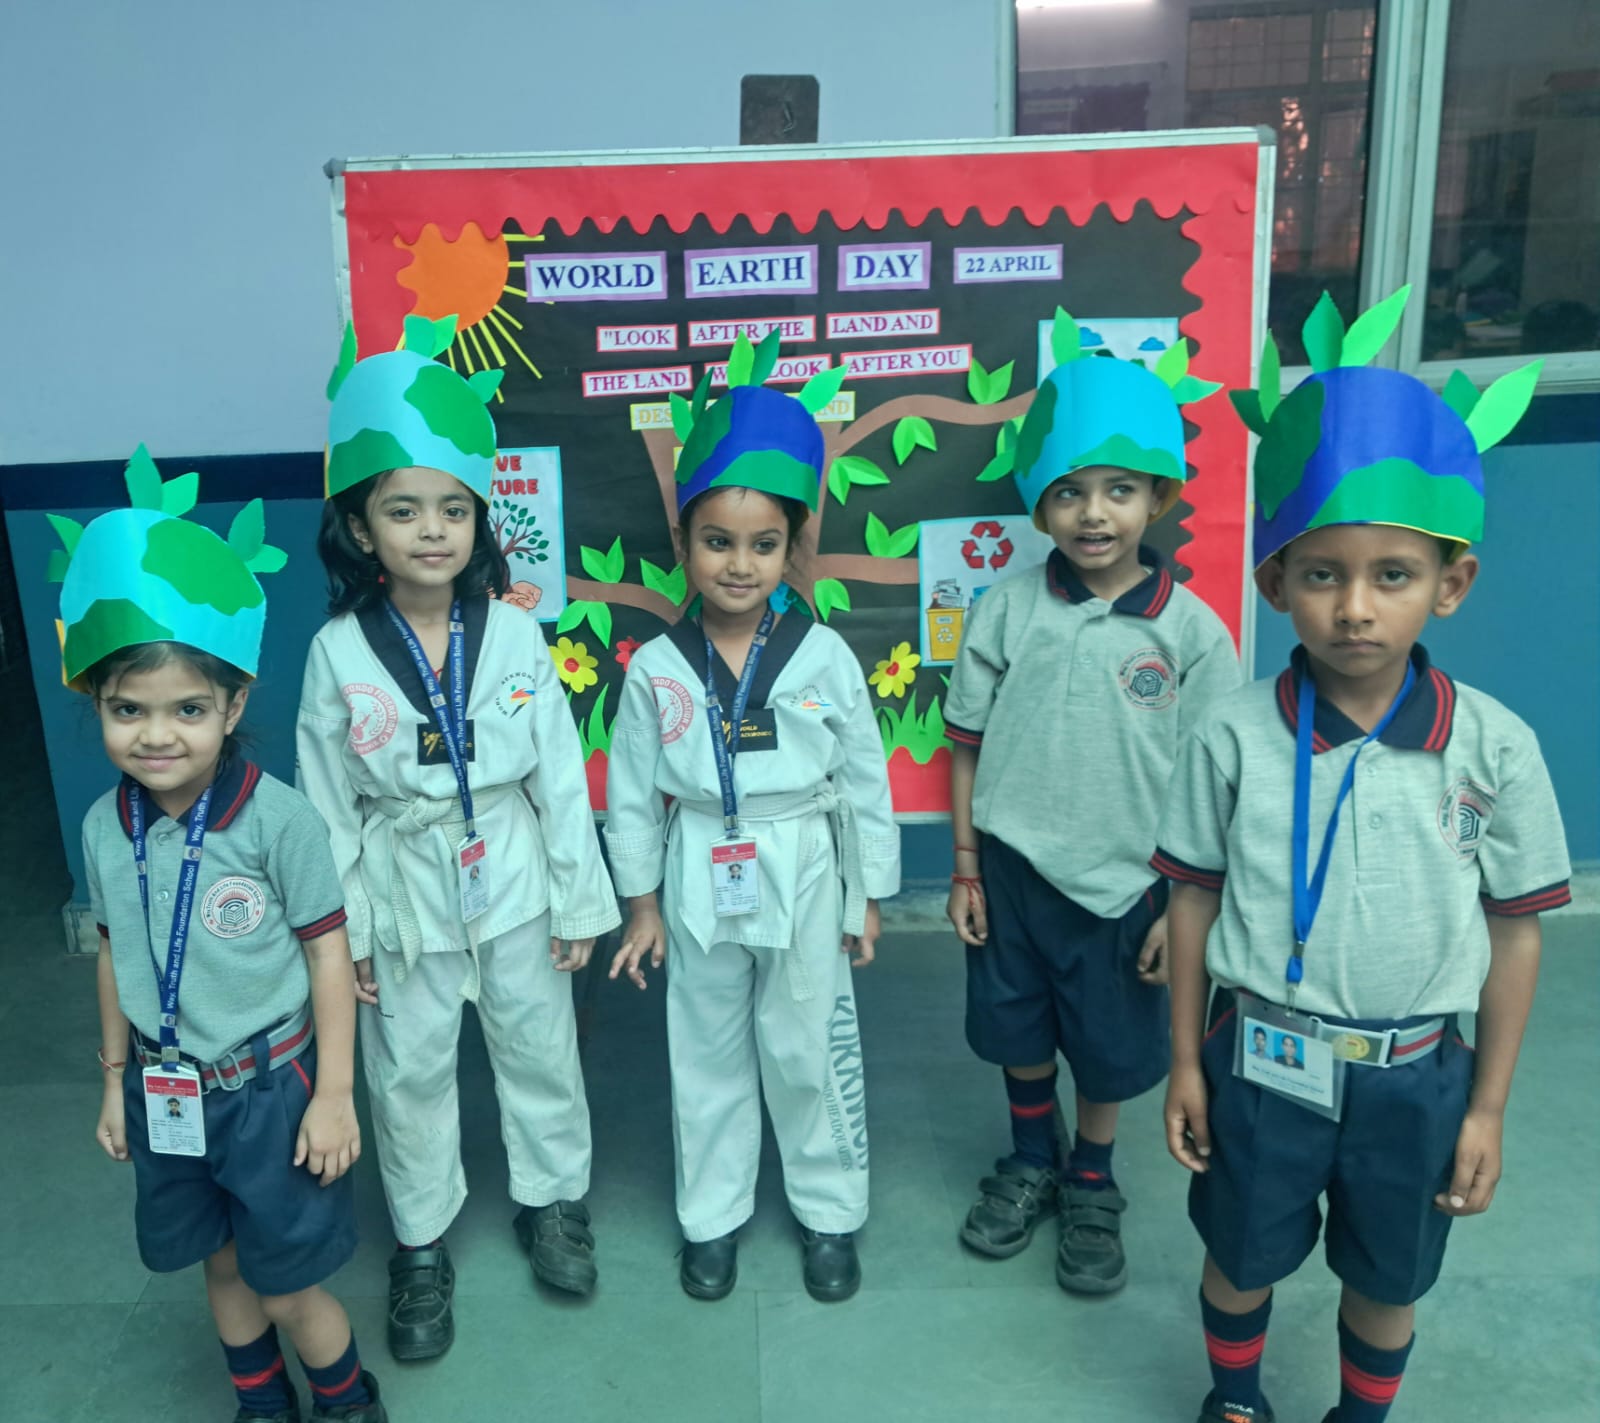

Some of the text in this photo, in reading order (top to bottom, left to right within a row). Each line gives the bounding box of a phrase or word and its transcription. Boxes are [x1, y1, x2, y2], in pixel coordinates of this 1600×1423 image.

[536, 254, 1052, 289] WORLD EARTH DAY 22 APRIL
[764, 322, 804, 337] THE
[832, 317, 887, 333] LAND
[890, 314, 933, 330] AND
[590, 375, 629, 392] THE
[634, 371, 687, 388] LAND
[848, 354, 914, 373] AFTER
[918, 350, 961, 367] YOU
[183, 864, 197, 892] School
[176, 893, 190, 937] Foundation
[174, 938, 183, 953] Life
[172, 953, 181, 967] and
[168, 967, 178, 990] Truth
